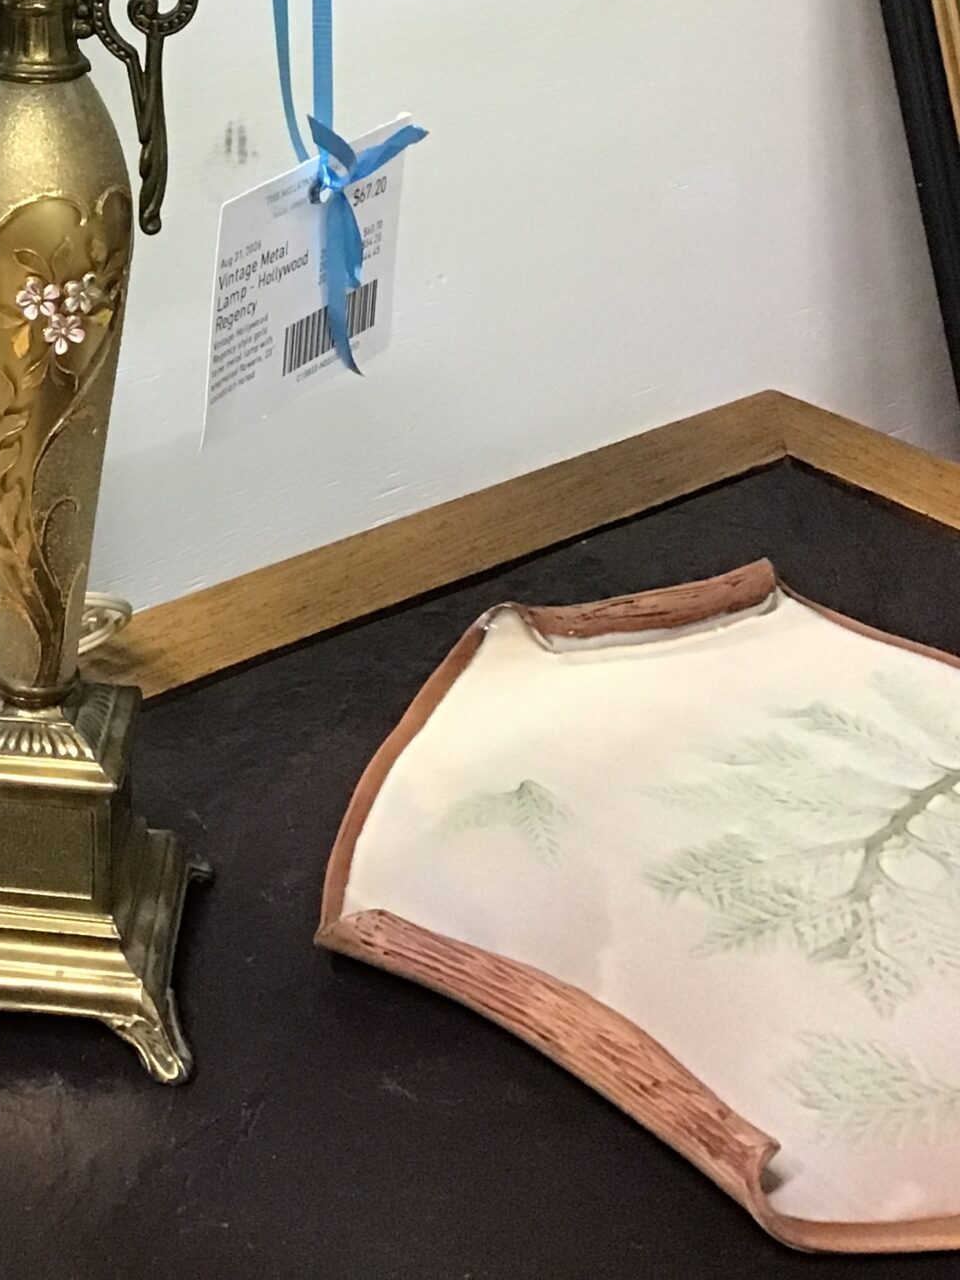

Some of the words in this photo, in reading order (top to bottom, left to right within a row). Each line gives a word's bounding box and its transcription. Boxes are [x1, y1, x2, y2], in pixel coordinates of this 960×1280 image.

[353, 175, 387, 206] $67.20
[216, 285, 247, 313] Lamp
[257, 248, 310, 290] Hollywood
[218, 260, 258, 291] Vintage
[260, 239, 289, 269] Metal
[215, 299, 259, 333] Regency
